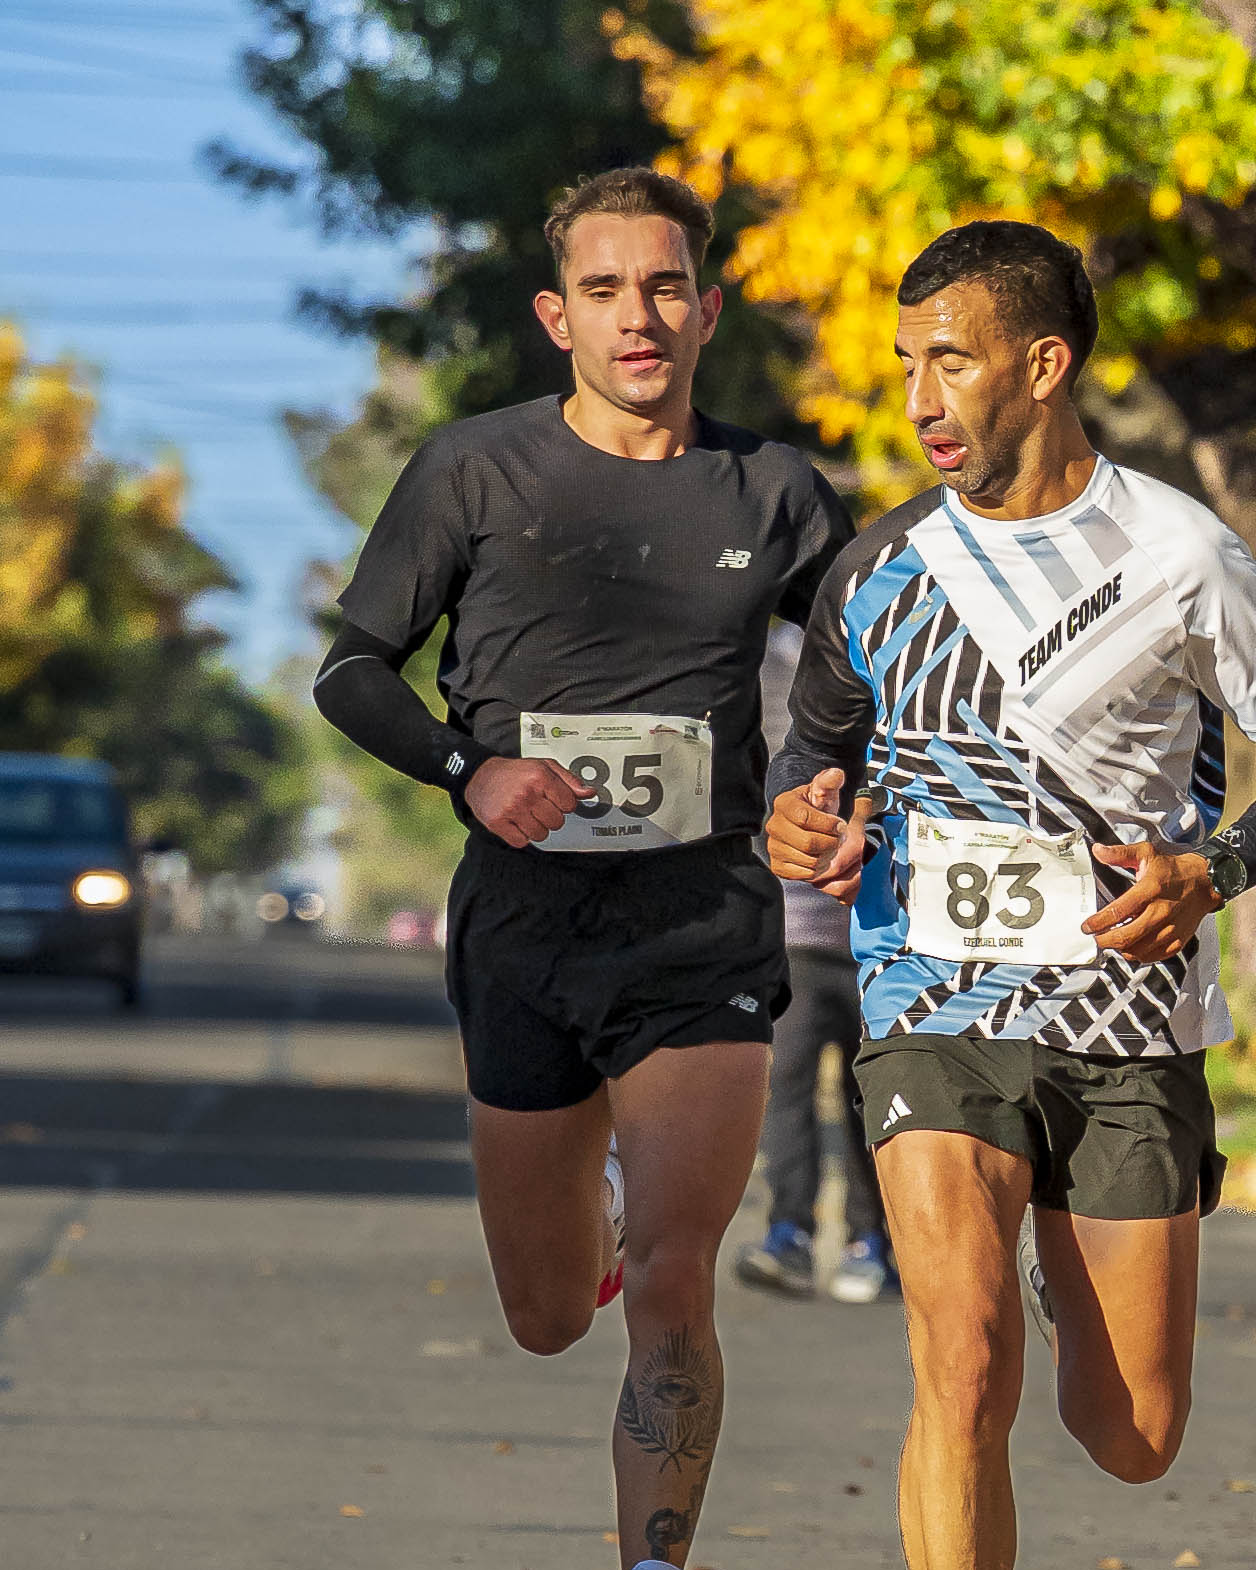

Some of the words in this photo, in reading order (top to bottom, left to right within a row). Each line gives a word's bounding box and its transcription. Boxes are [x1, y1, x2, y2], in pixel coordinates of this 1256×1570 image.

[1018, 620, 1062, 687] TEAM
[1066, 571, 1123, 642] CONDE
[569, 753, 664, 820] 85
[946, 862, 1045, 930] 83
